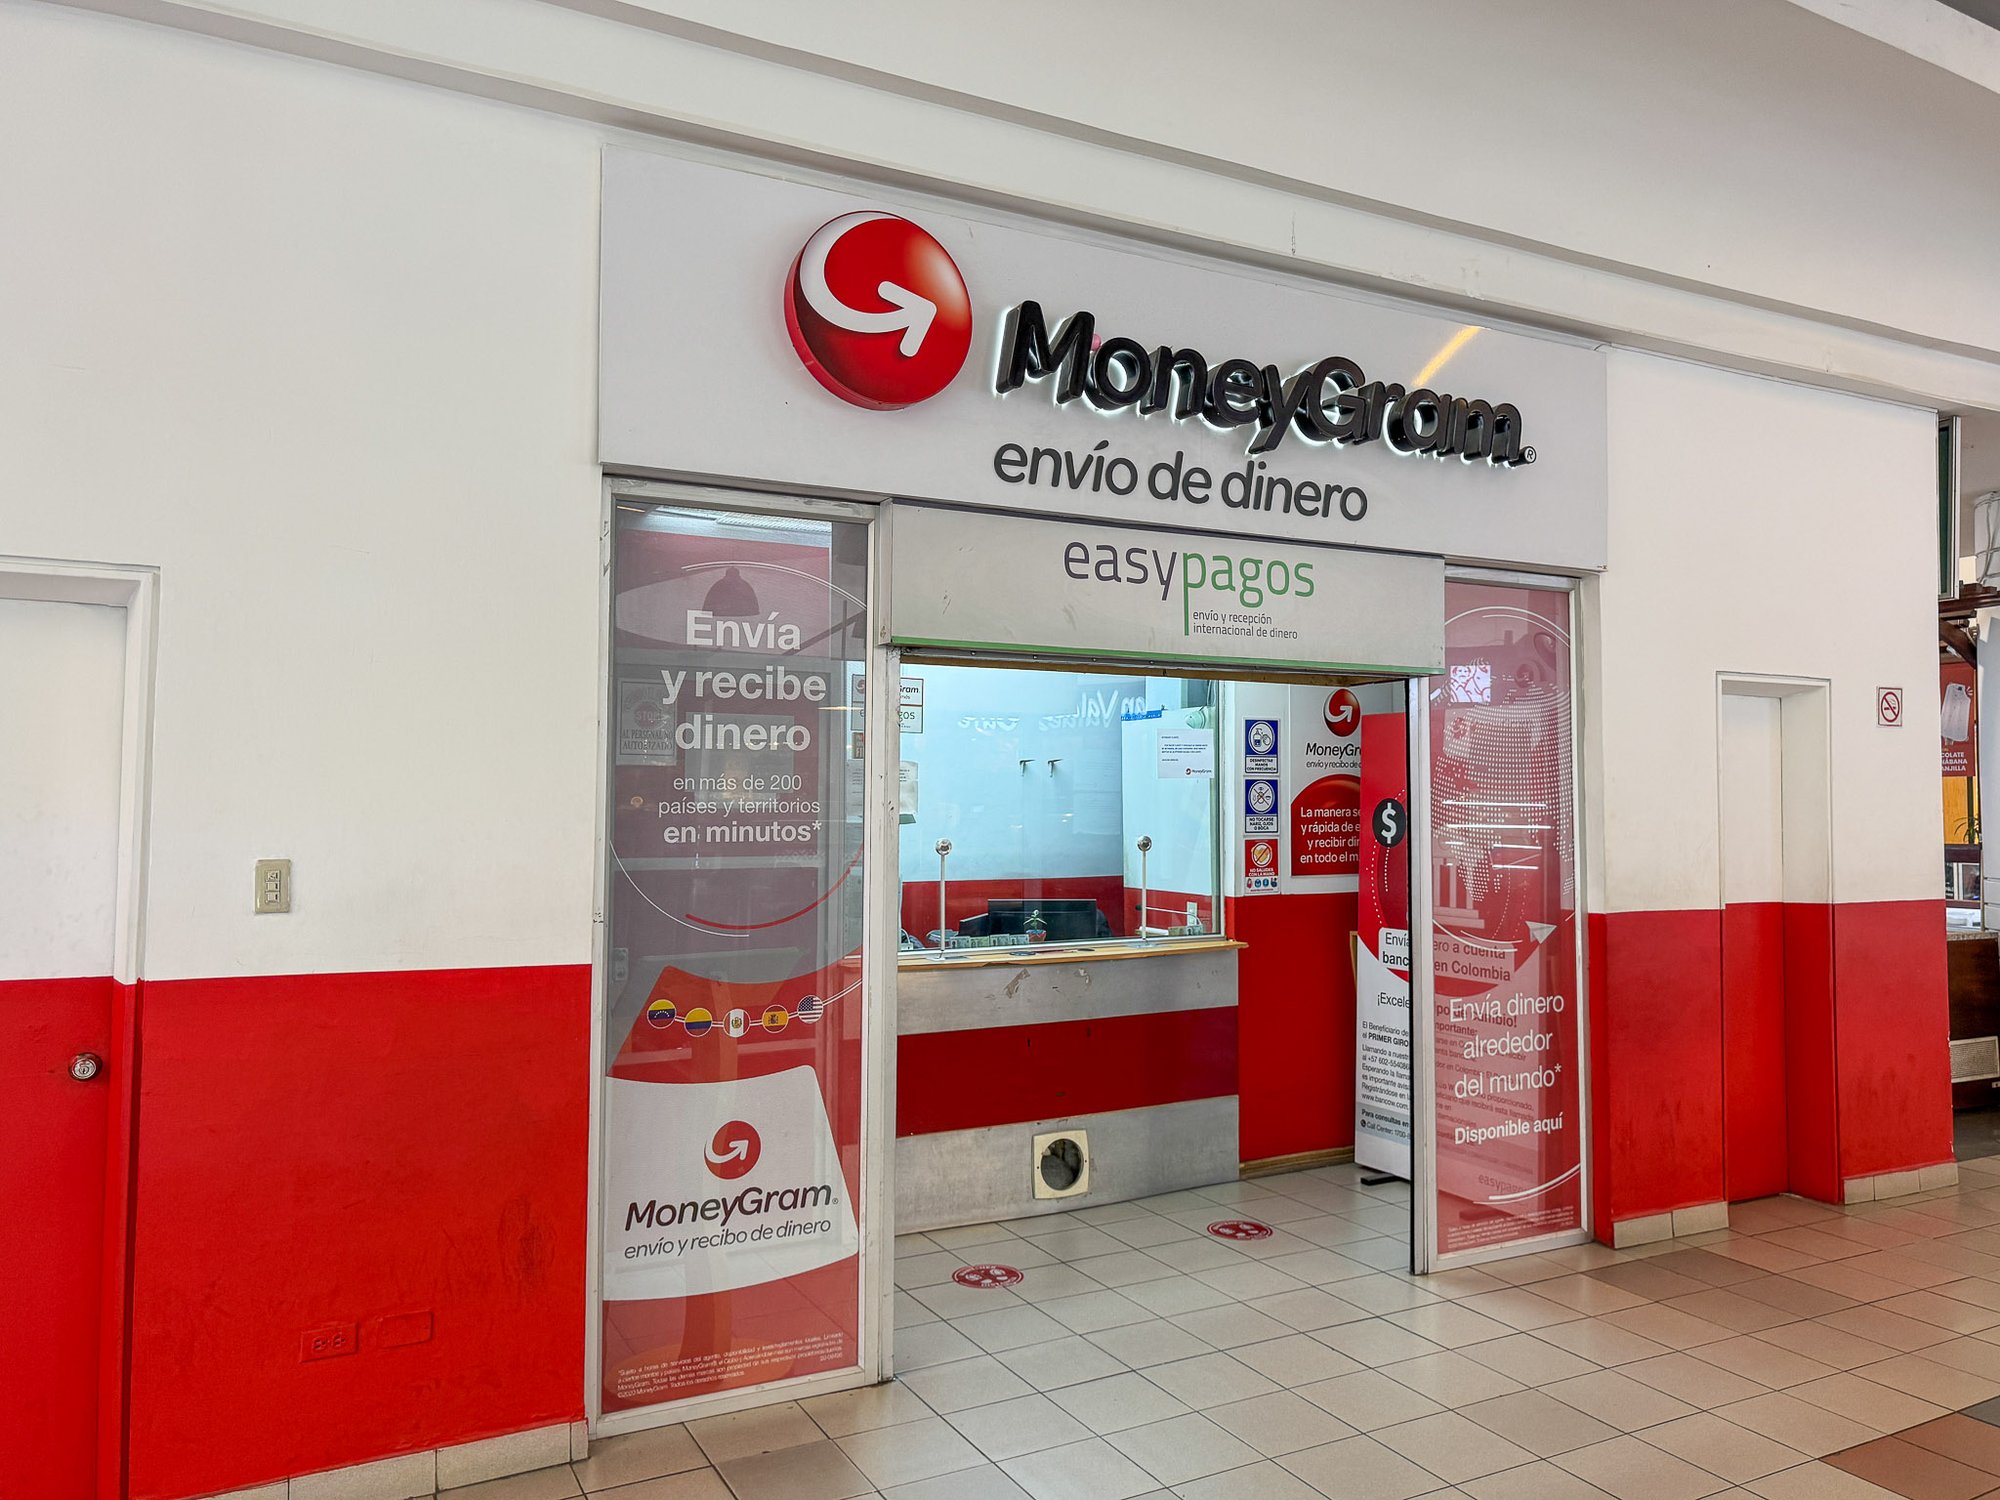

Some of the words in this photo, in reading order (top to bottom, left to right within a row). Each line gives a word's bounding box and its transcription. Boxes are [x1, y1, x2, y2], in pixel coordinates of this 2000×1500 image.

[994, 441, 1137, 496] envío
[1148, 450, 1212, 504] de
[1221, 460, 1367, 522] dinero
[1064, 541, 1315, 637] easypagos
[1193, 611, 1218, 622] envío
[1221, 614, 1227, 624] y
[1228, 613, 1272, 625] recepción
[686, 609, 801, 651] Envía
[1193, 623, 1253, 637] internacional
[1256, 626, 1268, 637] de
[1269, 628, 1298, 639] dinero
[661, 669, 687, 705] y
[695, 665, 827, 701] recibe
[675, 714, 811, 752] dinero
[1305, 742, 1361, 759] MoneyGr
[673, 778, 695, 791] en
[700, 773, 737, 791] más
[743, 775, 765, 791] de
[770, 775, 802, 791] 200
[658, 798, 717, 817] países
[723, 802, 734, 817] y
[738, 798, 821, 814] territorios
[1300, 807, 1313, 818] La
[1314, 808, 1351, 818] manera
[663, 826, 696, 844] en
[1300, 824, 1307, 835] y
[1308, 821, 1340, 835] rápida
[1341, 821, 1354, 832] de
[1307, 839, 1314, 851] y
[1315, 836, 1347, 848] recibir
[1300, 854, 1313, 864] en
[1314, 851, 1338, 863] todo
[1339, 851, 1348, 862] el
[1451, 960, 1511, 981] Colombia
[1450, 994, 1501, 1022] Envía
[1507, 993, 1564, 1016] dinero
[1369, 1031, 1392, 1044] PRIMER
[1393, 1037, 1409, 1047] GIRO
[1463, 1029, 1553, 1059] alrededor
[1454, 1072, 1483, 1098] del
[1455, 1119, 1530, 1144] Disponible
[1533, 1112, 1563, 1134] aquí
[624, 1236, 674, 1259] envío
[678, 1237, 689, 1256] y
[691, 1227, 748, 1250] recibo
[750, 1225, 774, 1242] de
[776, 1218, 832, 1239] dinero
